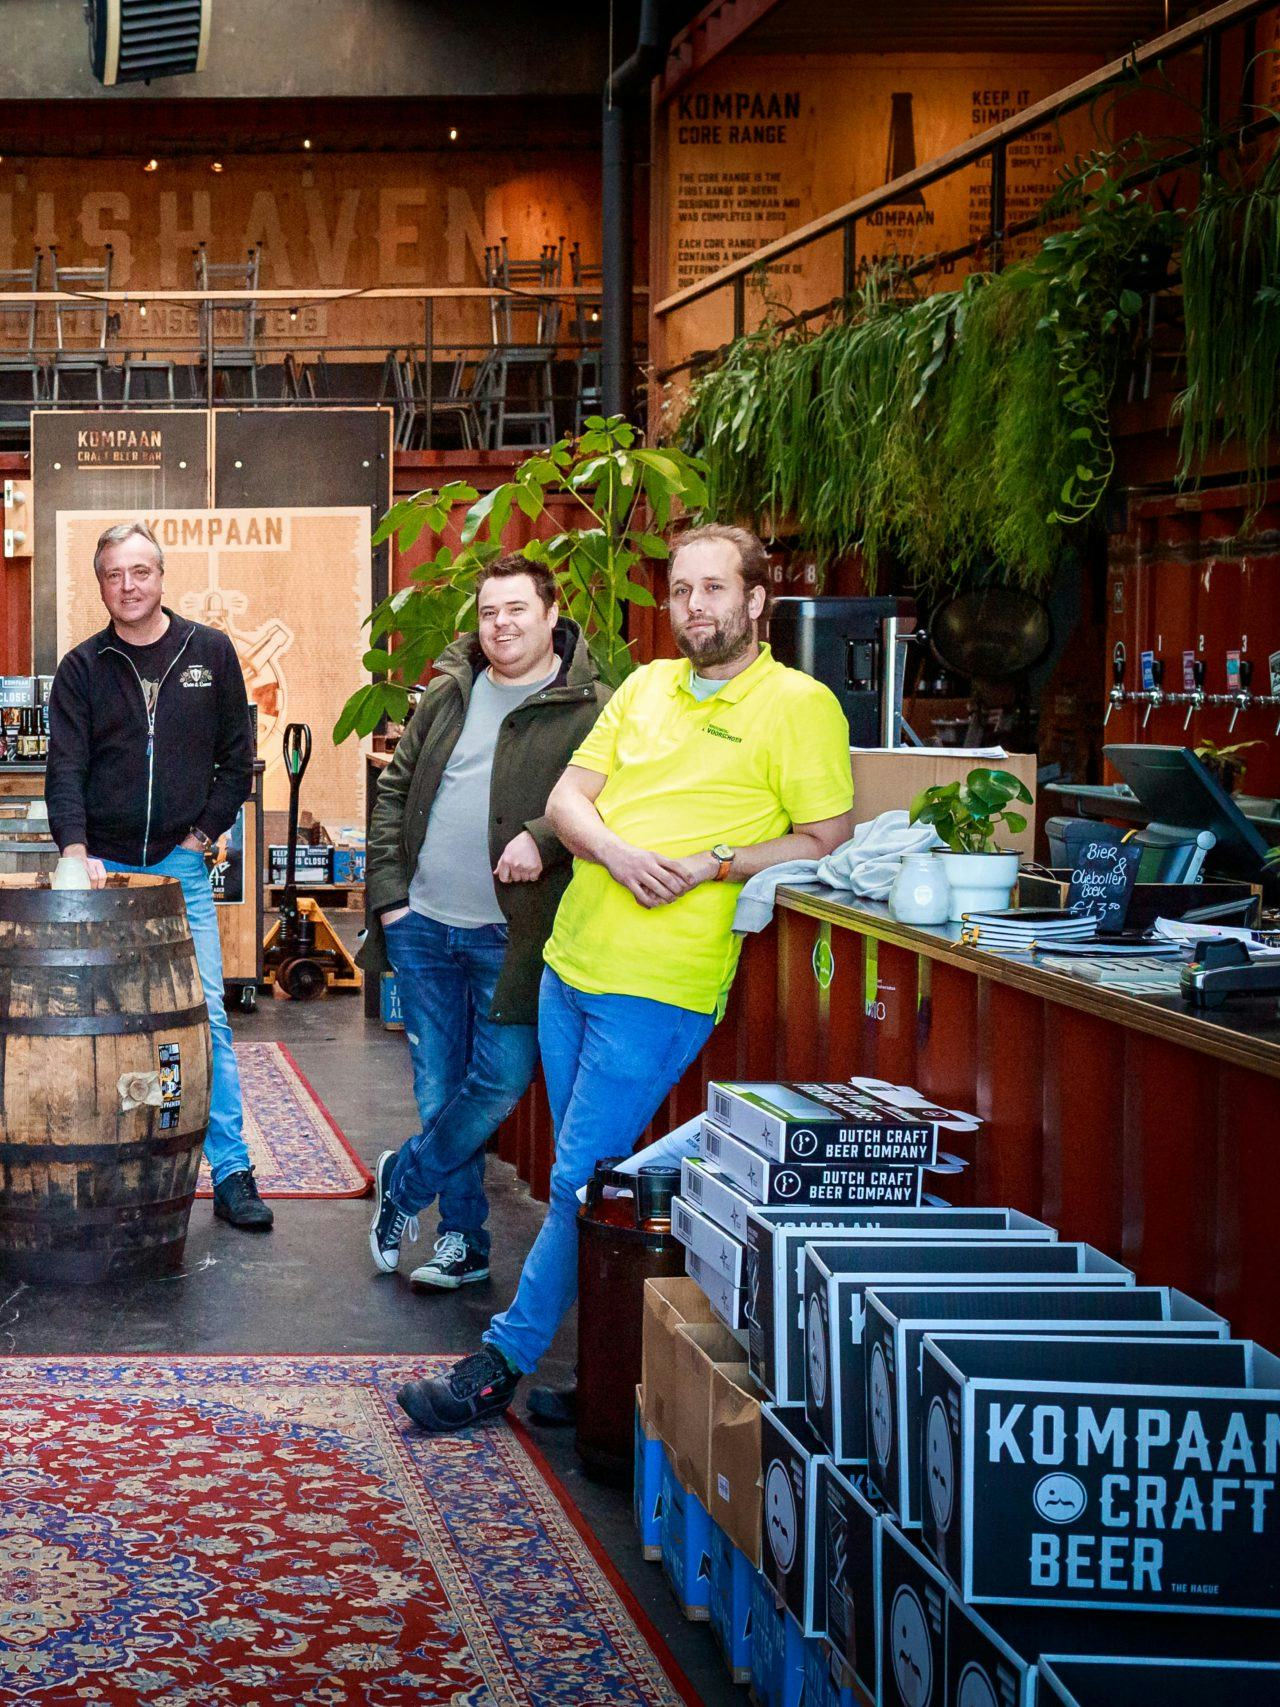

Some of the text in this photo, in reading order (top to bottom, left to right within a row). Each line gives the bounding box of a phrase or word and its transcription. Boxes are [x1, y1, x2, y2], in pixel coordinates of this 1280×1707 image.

[972, 90, 1030, 106] KEEP IT
[678, 93, 800, 120] KOMPAAN
[678, 125, 787, 145] CORE RANGE
[701, 212, 752, 222] COMPLETED
[866, 211, 934, 226] KOMPAAN
[678, 239, 756, 248] EACH CORE RANGE
[678, 252, 721, 262] CONTAINS
[78, 430, 162, 448] KOMPAAN
[144, 516, 283, 547] KOMPAAN
[1199, 634, 1205, 652] 2
[1241, 634, 1248, 652] 3
[1113, 857, 1127, 876] &
[839, 1129, 928, 1144] DUTCH CRAFT
[825, 1144, 928, 1159] BEER COMPANY
[822, 1170, 913, 1185] DUTCH CRAFT
[809, 1185, 912, 1200] BEER COMPANY
[1099, 1474, 1275, 1533] CRAFT
[1028, 1533, 1165, 1592] BEER
[1171, 1583, 1219, 1594] THE HAGUE
